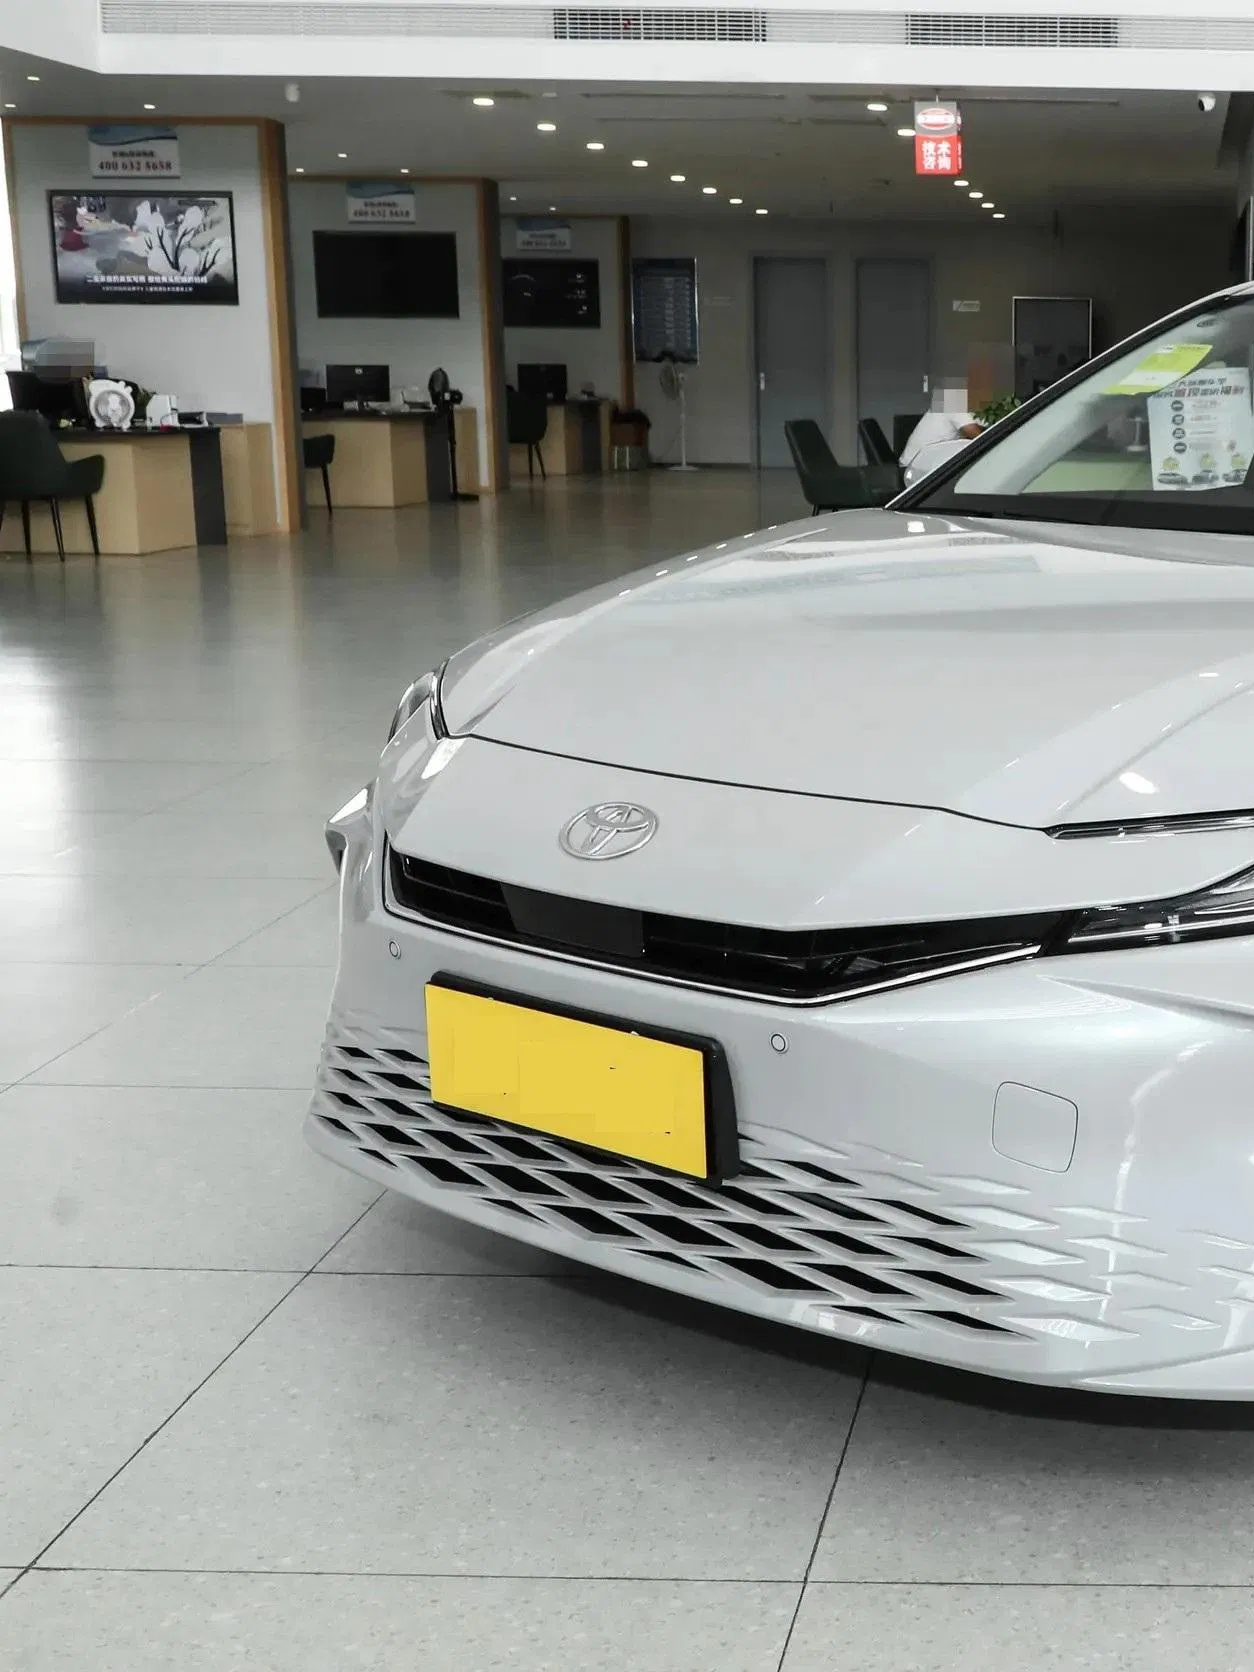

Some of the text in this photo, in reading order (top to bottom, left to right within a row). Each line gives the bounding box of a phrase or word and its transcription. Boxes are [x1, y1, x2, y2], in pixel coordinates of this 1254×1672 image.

[922, 140, 952, 156] 技术
[99, 160, 119, 171] 400
[922, 156, 952, 170] 咨询
